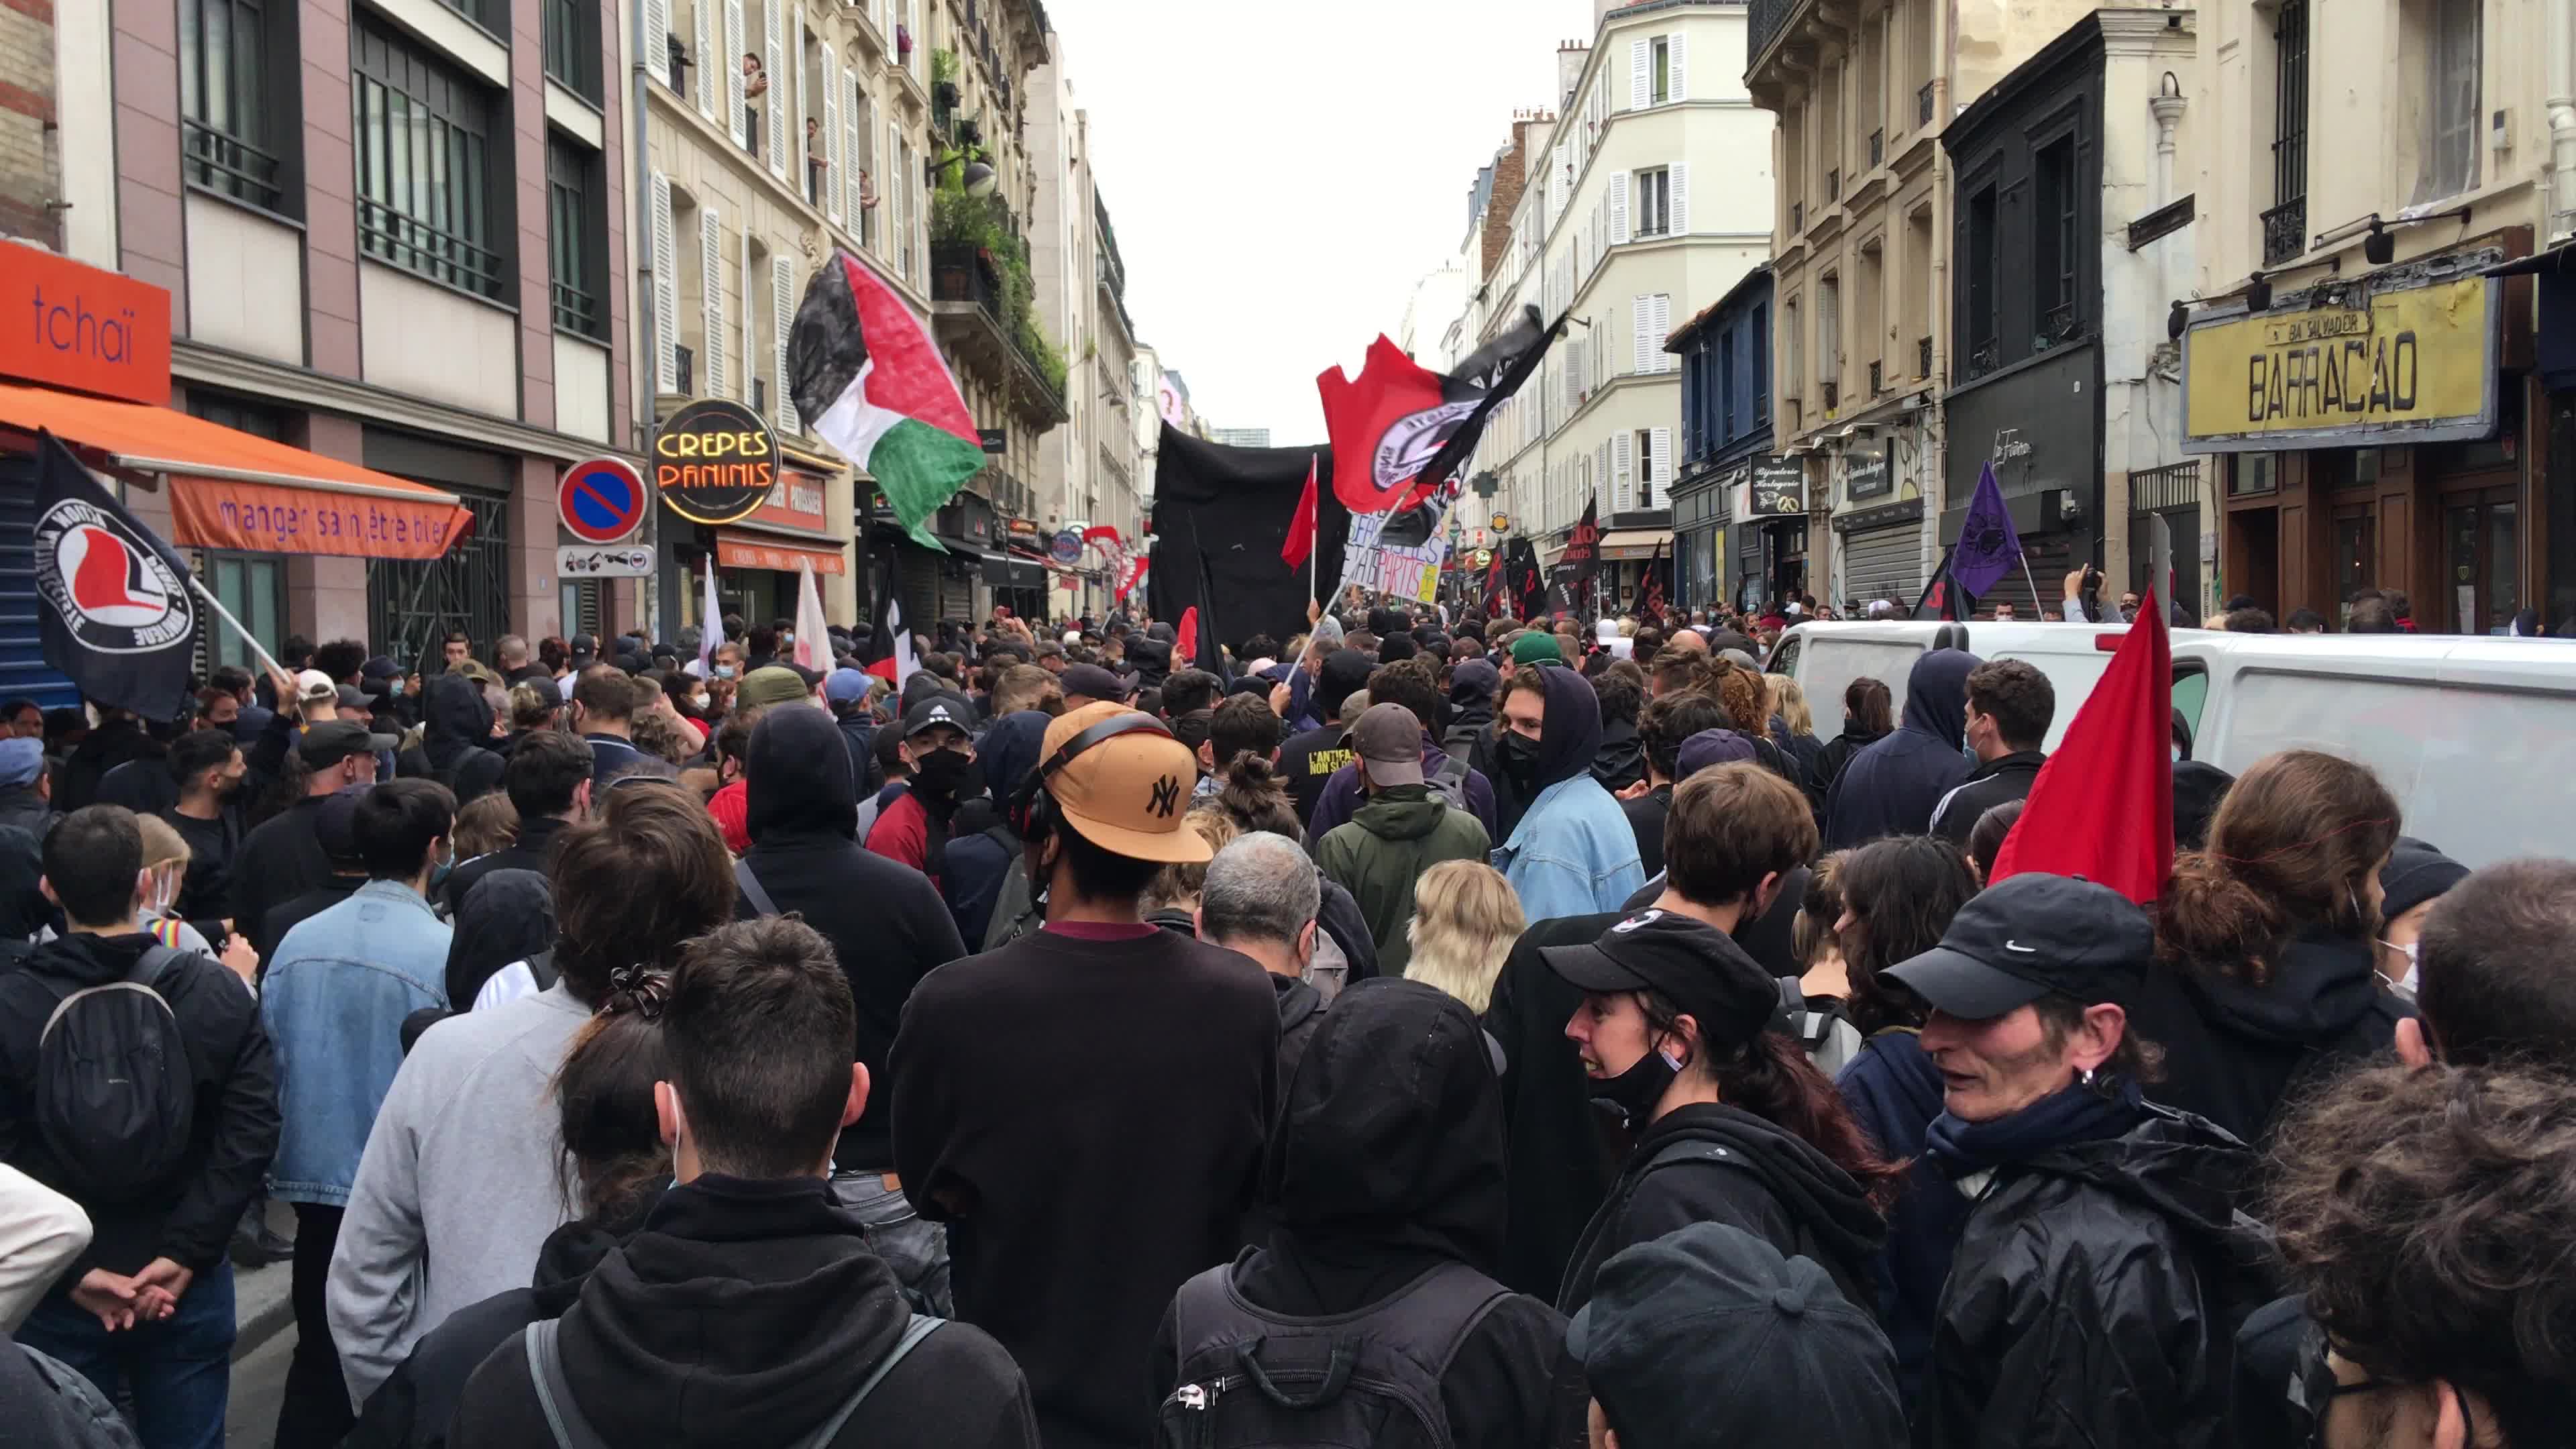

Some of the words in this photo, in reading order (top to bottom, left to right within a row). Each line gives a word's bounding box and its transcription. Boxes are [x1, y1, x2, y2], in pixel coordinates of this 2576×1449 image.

[32, 284, 135, 366] tchaï
[2249, 330, 2416, 421] BARRACAO
[657, 431, 769, 458] CREPES
[658, 462, 771, 488] PANINIS
[219, 500, 308, 541] manger
[1373, 547, 1426, 597] PARTIS
[1309, 749, 1353, 763] L'ANTIFA
[1309, 761, 1329, 775] NON
